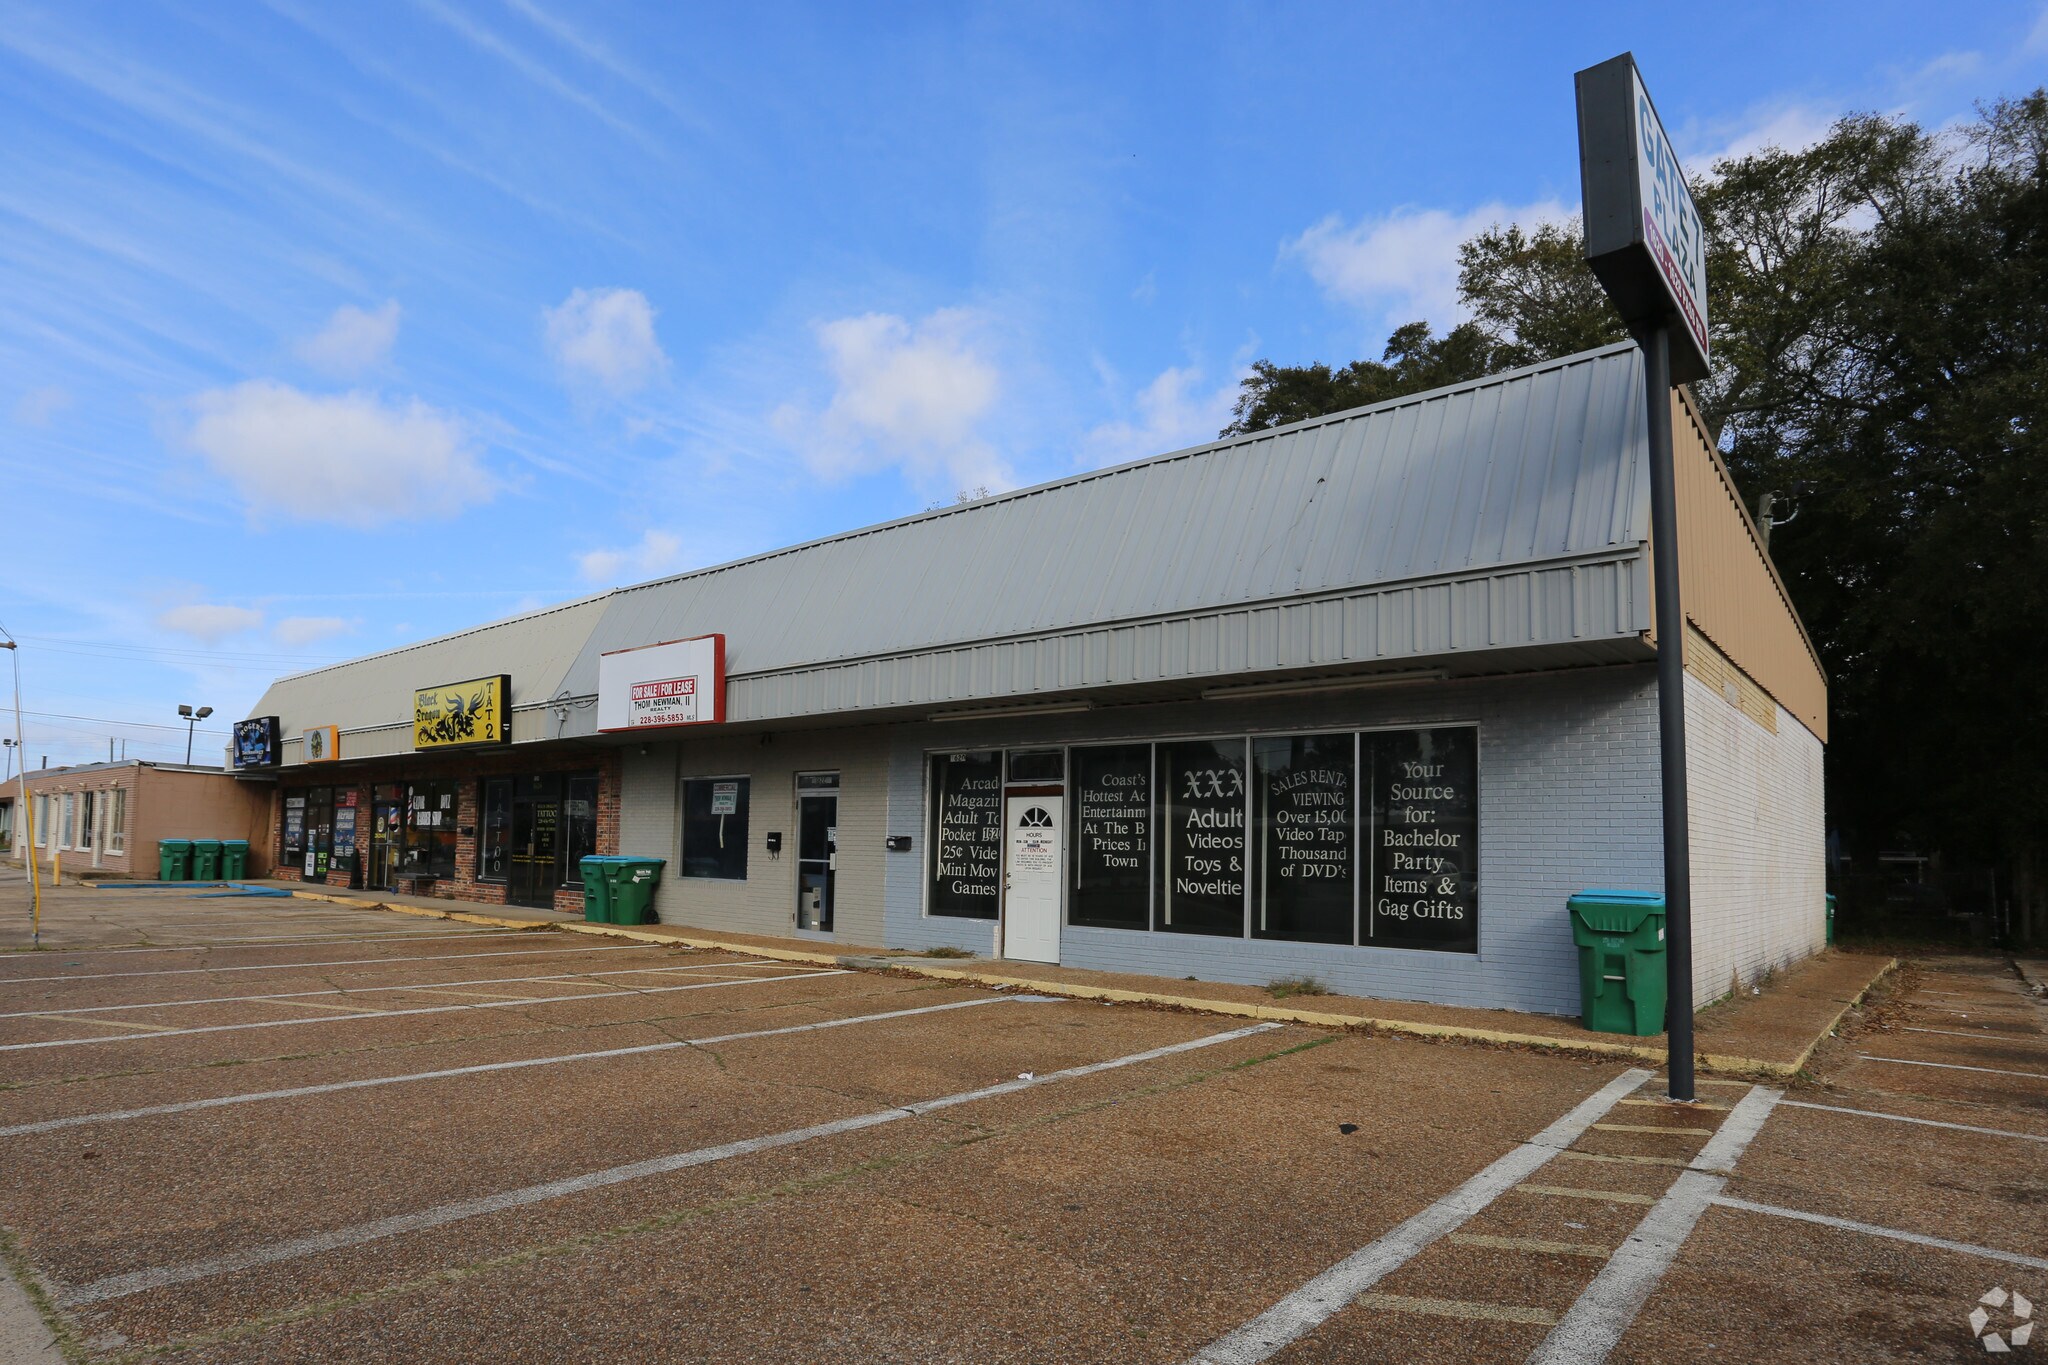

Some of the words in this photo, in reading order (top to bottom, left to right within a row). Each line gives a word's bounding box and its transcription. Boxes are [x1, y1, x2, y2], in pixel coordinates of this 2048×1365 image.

[1639, 95, 1689, 245] GATE
[1692, 211, 1700, 267] 7
[1653, 182, 1697, 300] PLAZA
[633, 686, 642, 699] FOR
[644, 685, 657, 698] SALE
[661, 683, 672, 695] FOR
[674, 681, 693, 694] LEASE
[418, 692, 438, 708] Black
[634, 700, 650, 710] THOM
[653, 697, 682, 706] NEWMAN,
[686, 696, 690, 706] II
[416, 709, 440, 725] Dragon
[640, 714, 684, 724] 228-396-5853
[240, 722, 265, 736] ROGERS
[1402, 761, 1444, 778] Your
[961, 776, 1000, 791] Arcad
[1101, 774, 1146, 786] Coast's
[1182, 768, 1243, 799] XXX
[1270, 771, 1308, 796] SALES
[1083, 790, 1123, 802] Hottest
[1292, 792, 1344, 806] VIEWING
[1391, 784, 1454, 801] Source
[943, 811, 978, 825] Adult
[1082, 806, 1145, 819] Entertainm
[1186, 808, 1243, 828] Adult
[1276, 810, 1311, 824] Over
[1404, 806, 1435, 823] for:
[942, 827, 976, 842] Pocket
[1084, 822, 1097, 835] At
[1104, 822, 1128, 835] The
[1135, 823, 1145, 835] B
[1277, 827, 1314, 841] Video
[1318, 828, 1346, 843] Tap
[1093, 838, 1130, 851] Prices
[1187, 833, 1243, 849] Videos
[1383, 829, 1461, 848] Bachelor
[943, 845, 963, 859] 25¢
[970, 846, 998, 860] Vide
[1279, 846, 1346, 860] Thousand
[1103, 854, 1138, 868] Town
[1184, 856, 1221, 876] Toys
[1230, 856, 1242, 871] &
[1393, 853, 1445, 874] Party
[940, 863, 967, 877] Mini
[969, 863, 998, 878] Mov
[1280, 863, 1295, 877] of
[952, 881, 996, 896] Games
[1177, 877, 1242, 896] Noveltie
[1384, 876, 1427, 894] Items
[1437, 877, 1456, 895] &
[1378, 899, 1409, 920] Gag
[1413, 900, 1464, 920] Gifts
